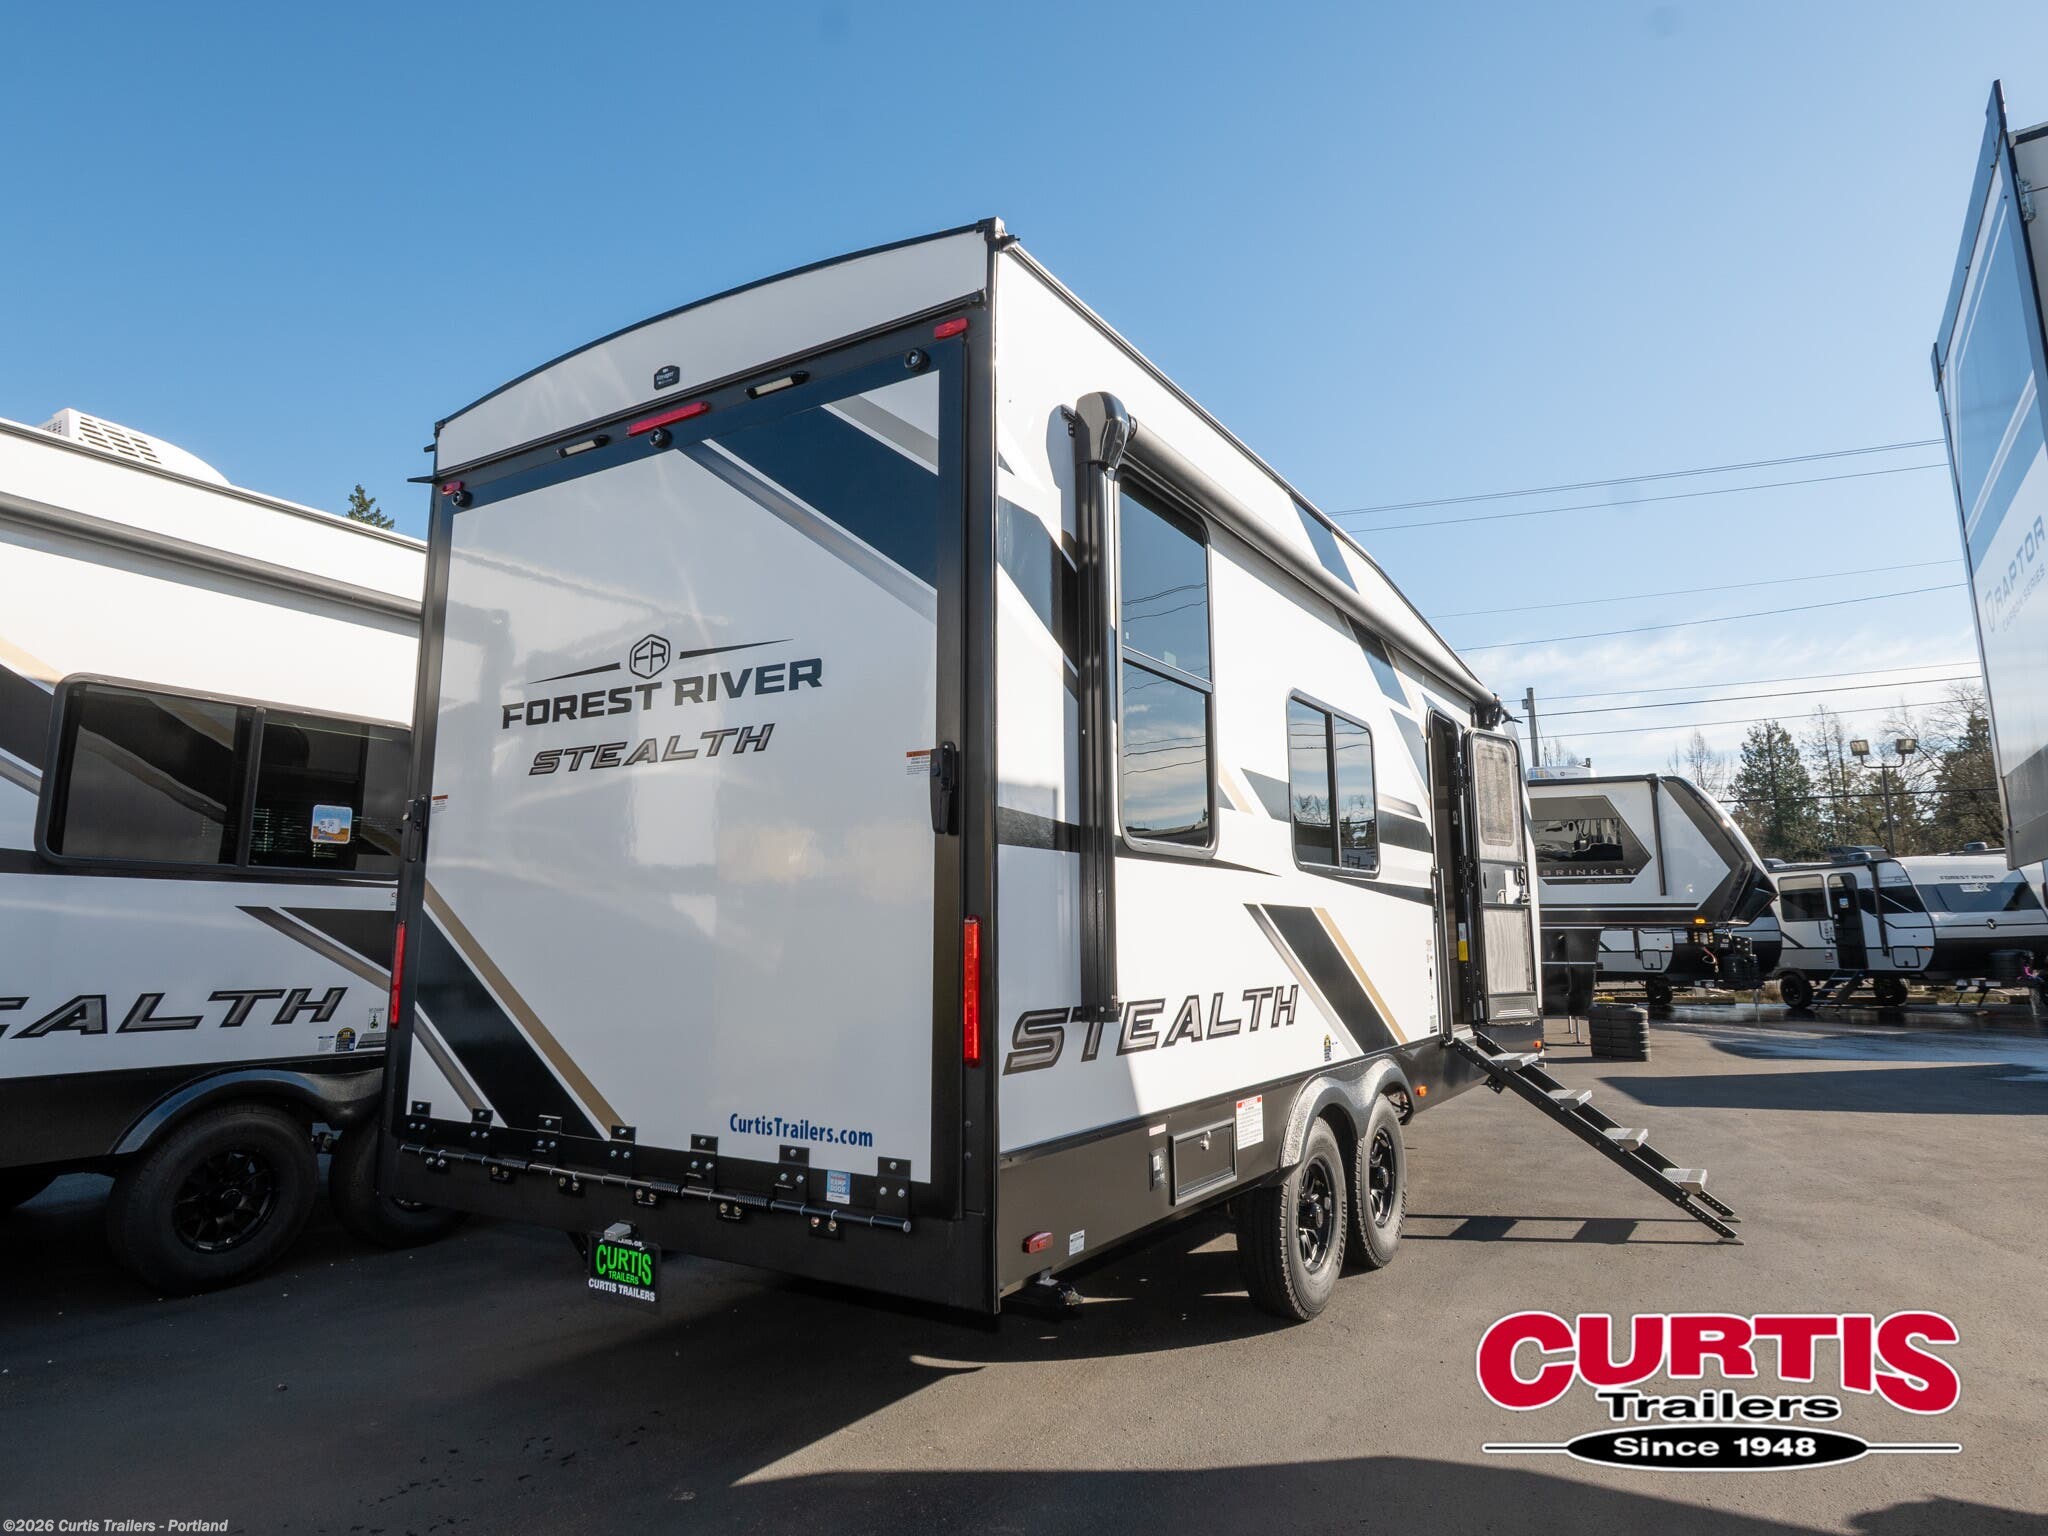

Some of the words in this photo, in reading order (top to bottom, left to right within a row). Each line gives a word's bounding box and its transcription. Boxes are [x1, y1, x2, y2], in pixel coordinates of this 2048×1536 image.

[1994, 515, 2045, 614] RAPTOR
[502, 682, 662, 729] FOREST
[673, 658, 823, 707] RIVER
[528, 723, 776, 776] STEALTH
[1542, 868, 1637, 876] BRINKLEY
[1003, 984, 1298, 1076] STEALTH
[729, 1112, 873, 1148] CurtisTrailers.com
[1337, 1200, 1346, 1268] WESTLAKE
[596, 1244, 652, 1286] CURTIS
[608, 1270, 640, 1285] TRAILERS
[588, 1278, 617, 1293] CURTIS
[618, 1284, 656, 1302] TRAILERS
